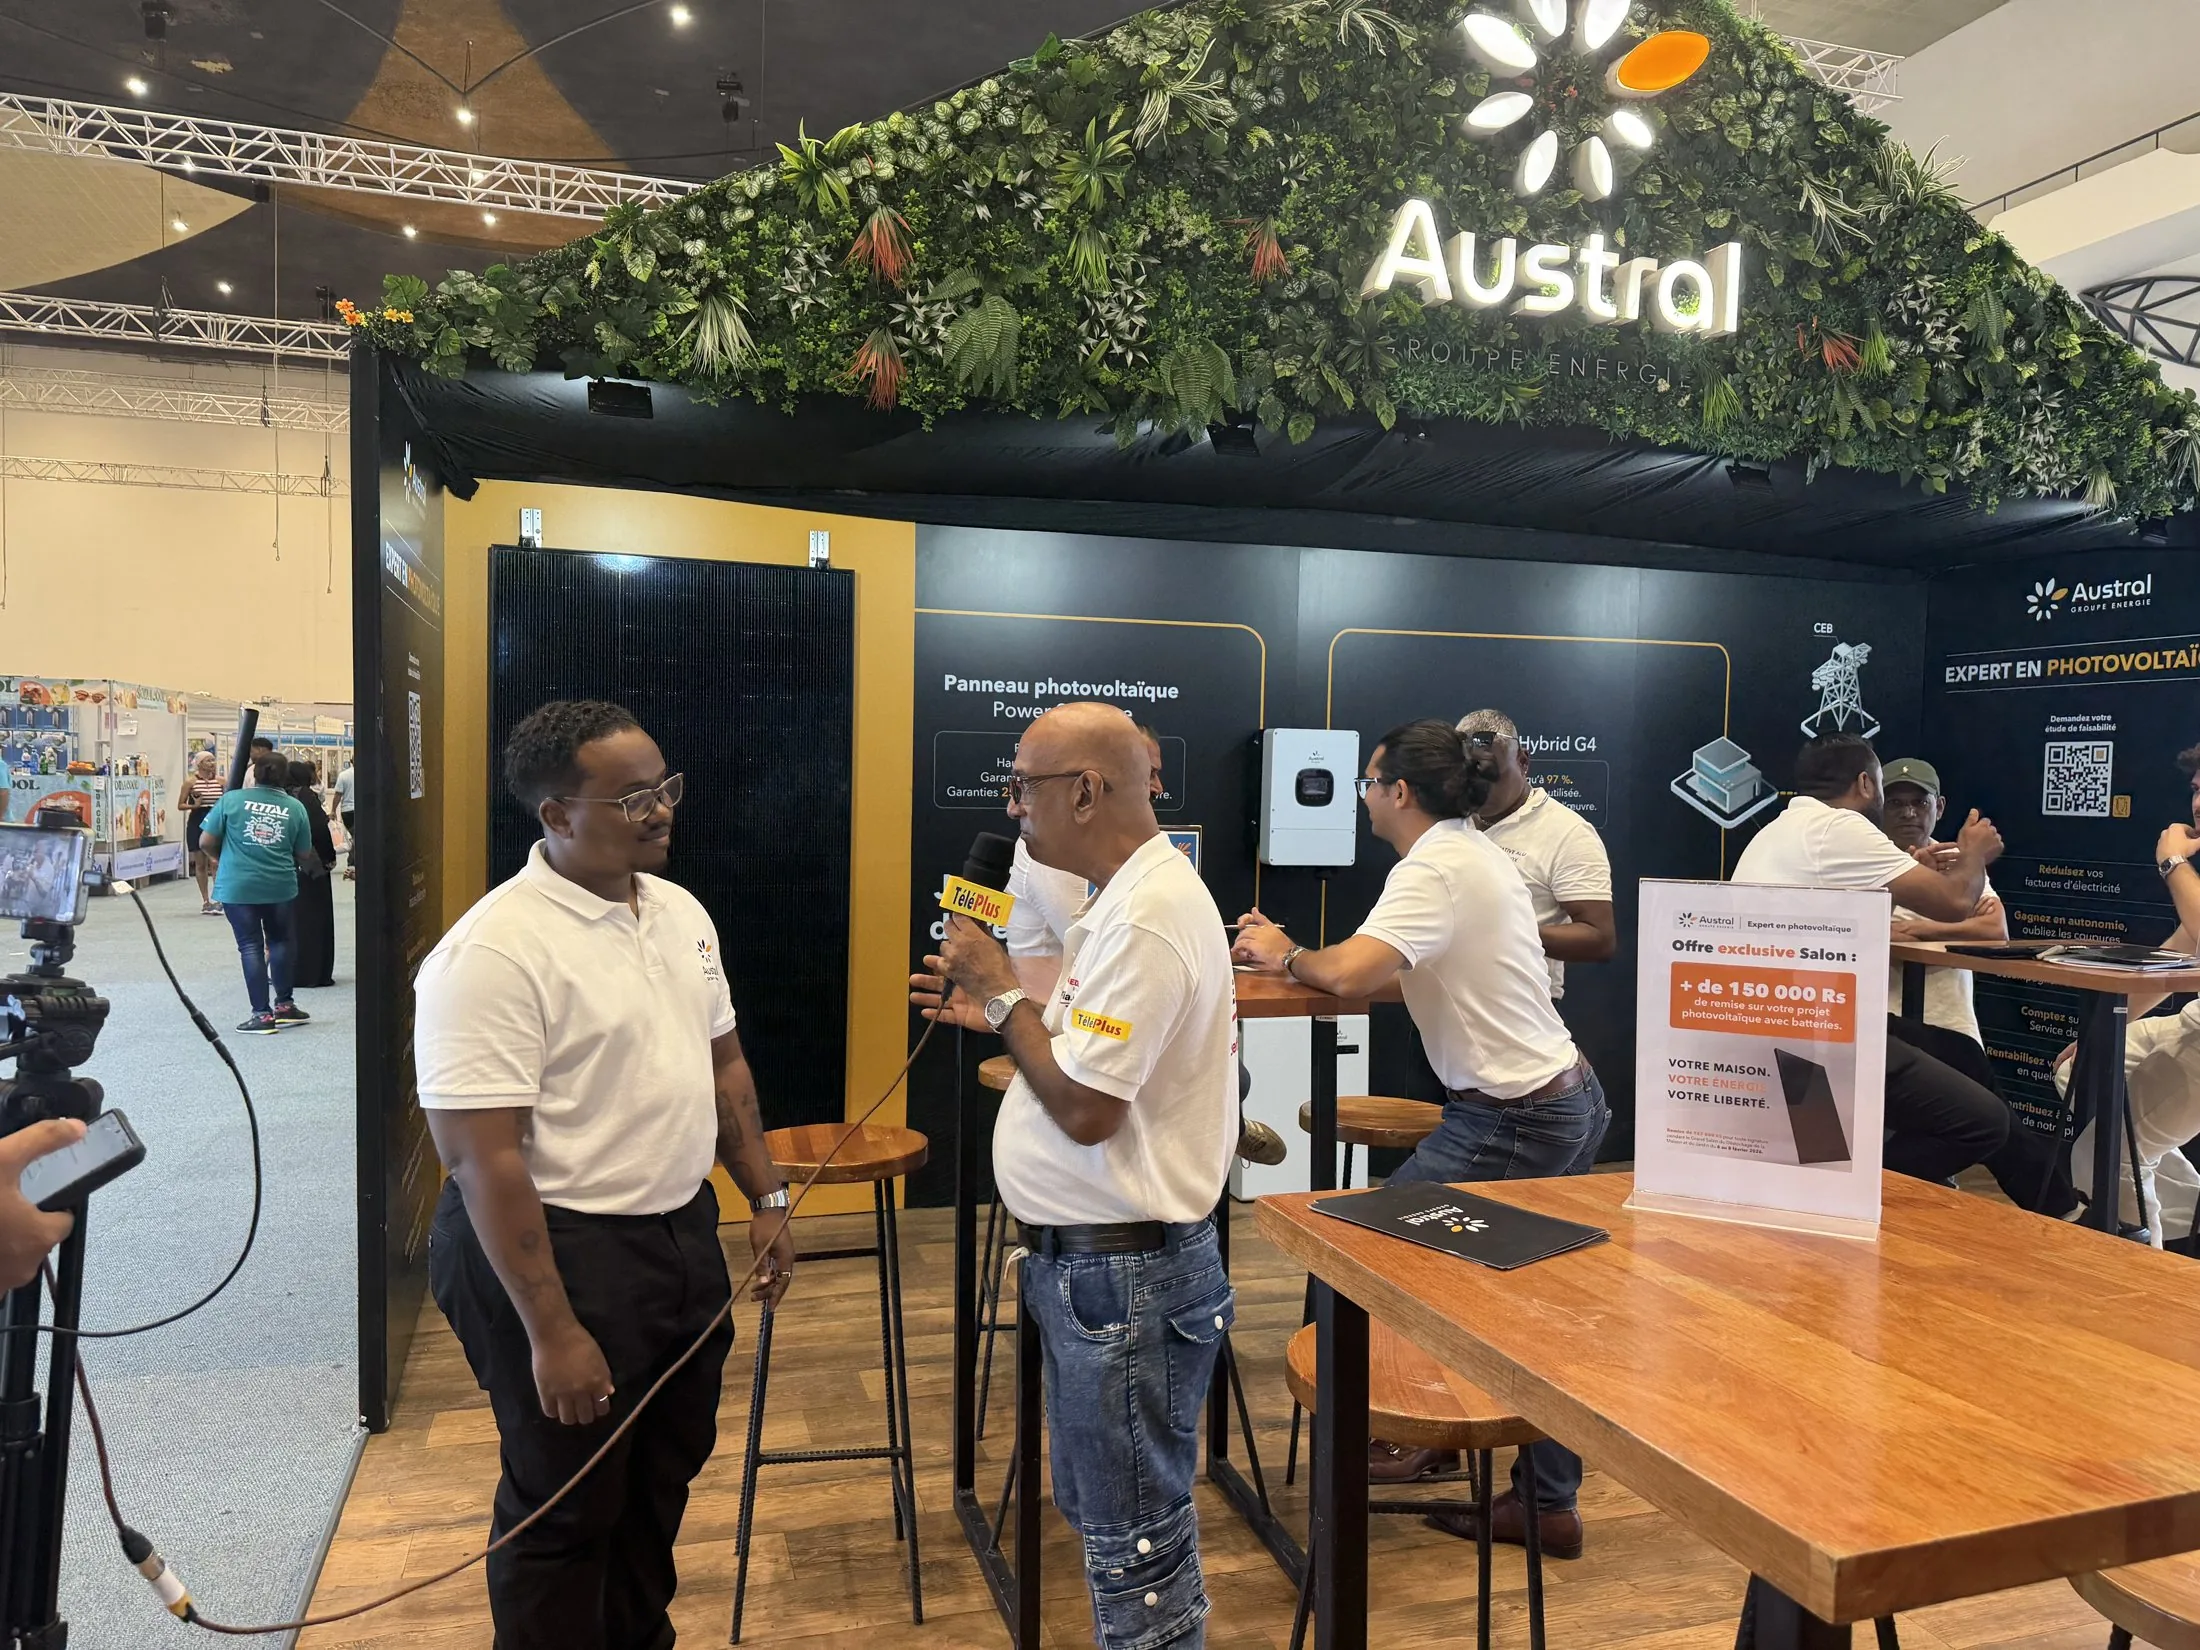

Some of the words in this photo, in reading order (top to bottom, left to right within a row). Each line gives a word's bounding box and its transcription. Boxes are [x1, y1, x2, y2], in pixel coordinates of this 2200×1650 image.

[1361, 198, 1742, 340] Austral
[1387, 338, 1523, 370] ROUPE
[2071, 573, 2152, 602] Austral
[2071, 603, 2107, 613] GROUPE
[2112, 599, 2151, 610] ENERGIE
[1814, 622, 1833, 633] CEB
[1945, 661, 2012, 683] EXPERT
[2016, 660, 2041, 678] EN
[2047, 643, 2200, 676] PHOTOVOLTAÏ
[944, 674, 1029, 694] Panneau
[1034, 677, 1179, 702] photovoltaïque
[2045, 724, 2067, 733] étude
[2068, 724, 2078, 732] de
[2079, 723, 2117, 732] faisabilité
[2050, 714, 2090, 723] Demandez
[2091, 714, 2112, 722] votre
[1519, 735, 1570, 755] Hybrid
[1574, 736, 1597, 752] G4
[1526, 775, 1545, 786] qu'à
[1546, 775, 1559, 784] 97
[946, 786, 999, 798] Garanties
[1547, 788, 1582, 798] utilisée.
[2039, 864, 2084, 877] Réduisez
[2087, 869, 2104, 879] vos
[2025, 877, 2061, 889] factures
[2064, 880, 2121, 894] d'électricité
[953, 886, 1001, 919] TéléPlus
[1699, 915, 1735, 925] Austral
[1747, 921, 1774, 930] Expert
[1788, 923, 1852, 934] photovoltaïque
[2014, 910, 2051, 923] Gagnez
[2053, 916, 2066, 924] en
[2068, 917, 2128, 933] autonomie,
[2022, 926, 2057, 938] oubliez
[2058, 927, 2072, 939] les
[1672, 939, 1714, 953] Offre
[1717, 943, 1795, 958] exclusive
[1800, 947, 1846, 962] Salon
[1851, 953, 1857, 962] :
[1680, 980, 1692, 991] +
[1697, 979, 1723, 995] de
[1729, 981, 1769, 998] 150
[1774, 984, 1816, 1002] 000
[1822, 988, 1846, 1005] Rs
[1694, 997, 1708, 1007] de
[1710, 1000, 1745, 1010] remise
[1748, 1003, 1764, 1011] sur
[1766, 1004, 1794, 1014] votre
[1797, 1006, 1830, 1020] projet
[2021, 1006, 2066, 1022] Comptez
[2068, 1015, 2080, 1025] su
[1078, 1014, 1122, 1036] TéléPlus
[1682, 1009, 1762, 1024] photovoltaïque
[1764, 1016, 1789, 1026] avec
[1792, 1017, 1842, 1031] batteries.
[2029, 1021, 2063, 1036] Service
[1986, 1046, 2045, 1066] Rentabilisez
[1668, 1058, 1709, 1071] VOTRE
[1713, 1063, 1771, 1077] MAISON.
[2017, 1067, 2029, 1076] en
[1668, 1074, 1709, 1087] VOTRE
[1668, 1089, 1710, 1102] VOTRE
[1714, 1094, 1770, 1109] LIBERTÉ.
[2022, 1116, 2035, 1127] de
[2037, 1120, 2056, 1132] notr
[1405, 1206, 1464, 1226] Austral
